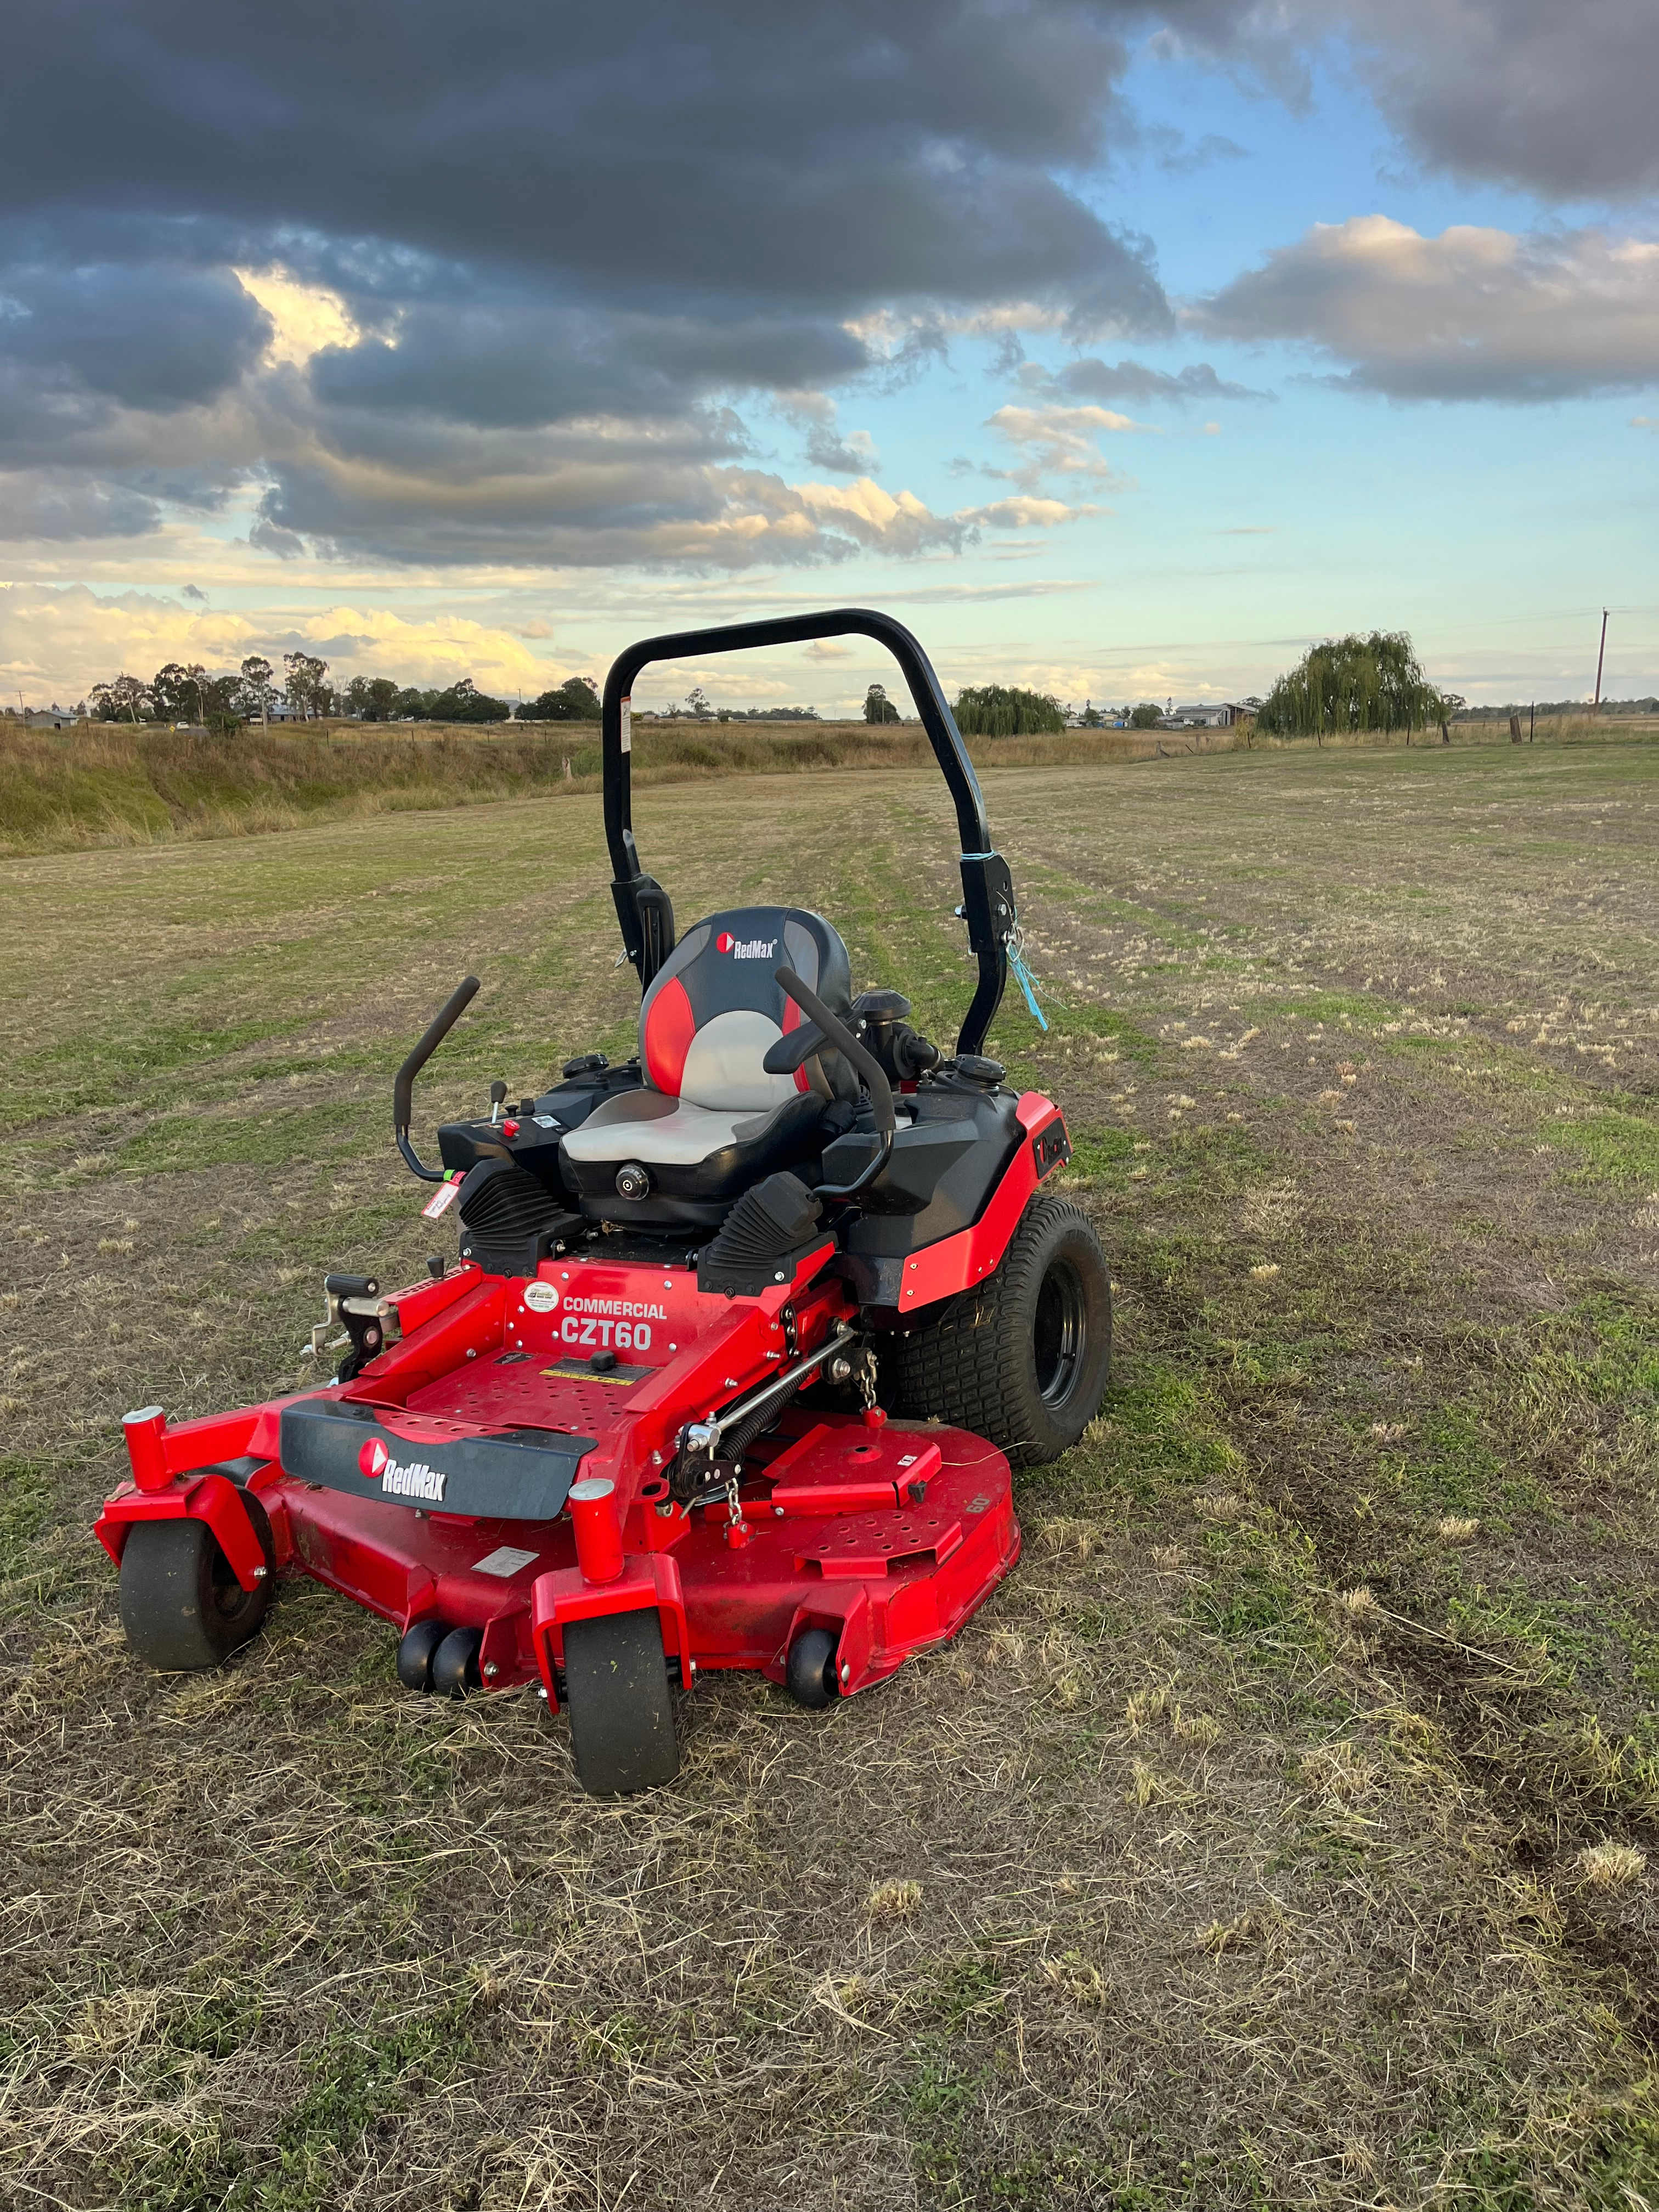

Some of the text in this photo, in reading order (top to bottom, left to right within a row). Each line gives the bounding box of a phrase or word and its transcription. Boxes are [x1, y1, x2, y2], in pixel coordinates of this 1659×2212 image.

[734, 940, 773, 959] RedMax
[563, 1296, 667, 1319] COMMERCIAL
[561, 1317, 651, 1350] CZT60
[382, 1459, 445, 1502] RedMax
